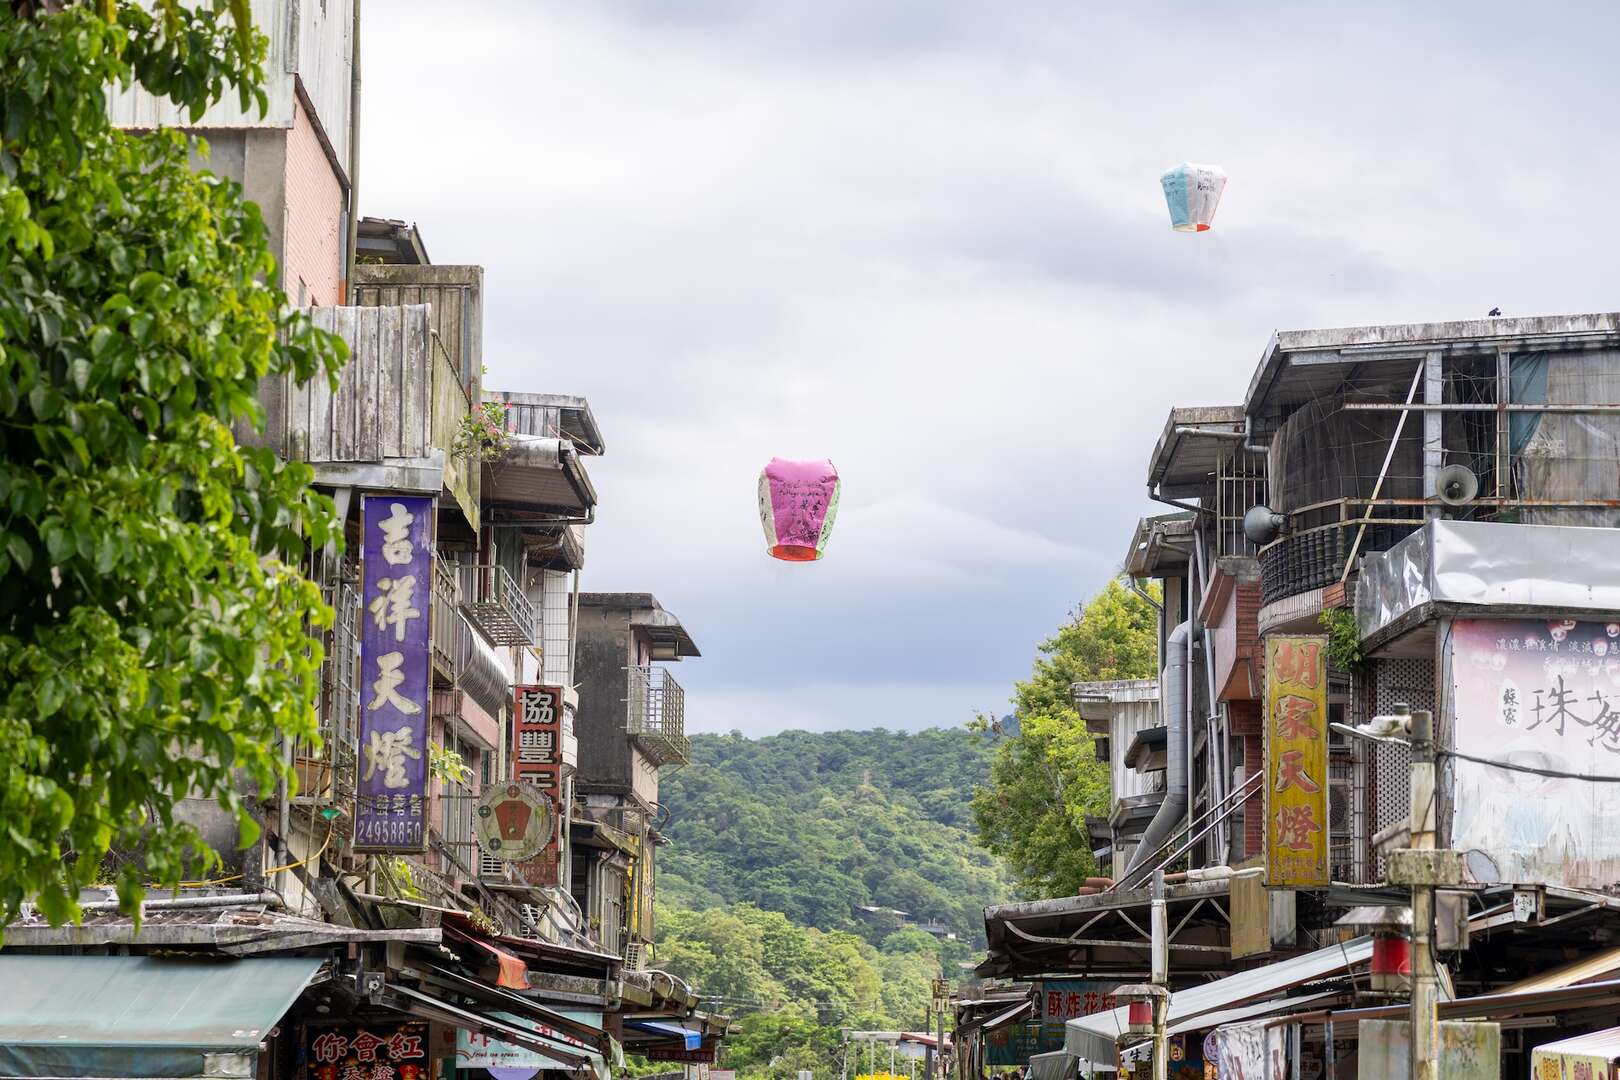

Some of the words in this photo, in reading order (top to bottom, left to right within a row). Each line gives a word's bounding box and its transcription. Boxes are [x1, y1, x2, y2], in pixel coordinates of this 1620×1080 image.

[362, 502, 422, 789] 吉祥天燈
[1503, 687, 1519, 725] 蘇家
[312, 1032, 425, 1062] 你會紅
